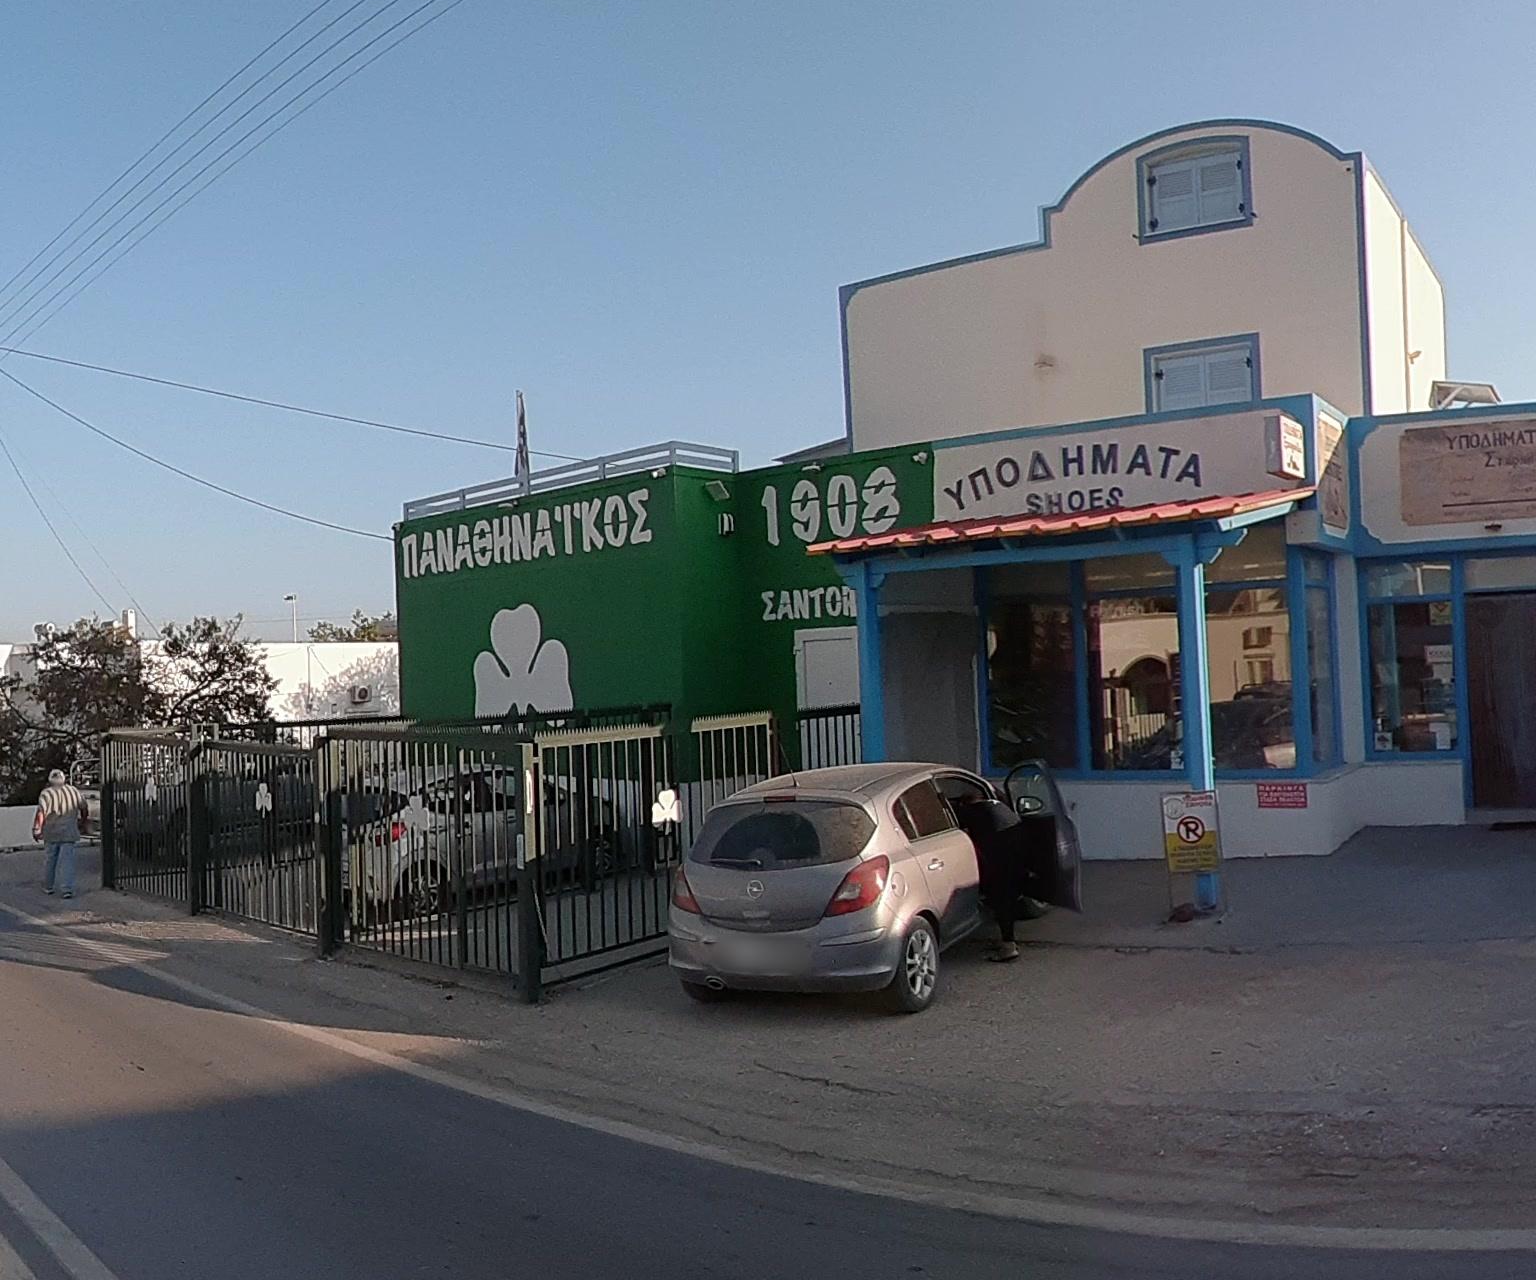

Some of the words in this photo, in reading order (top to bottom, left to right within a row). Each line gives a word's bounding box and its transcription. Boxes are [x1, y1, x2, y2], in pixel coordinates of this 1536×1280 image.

[760, 465, 901, 547] 1908
[944, 442, 1203, 512] ΥΠΟΔΗΜΑΤΑ
[1026, 486, 1125, 517] SHOES
